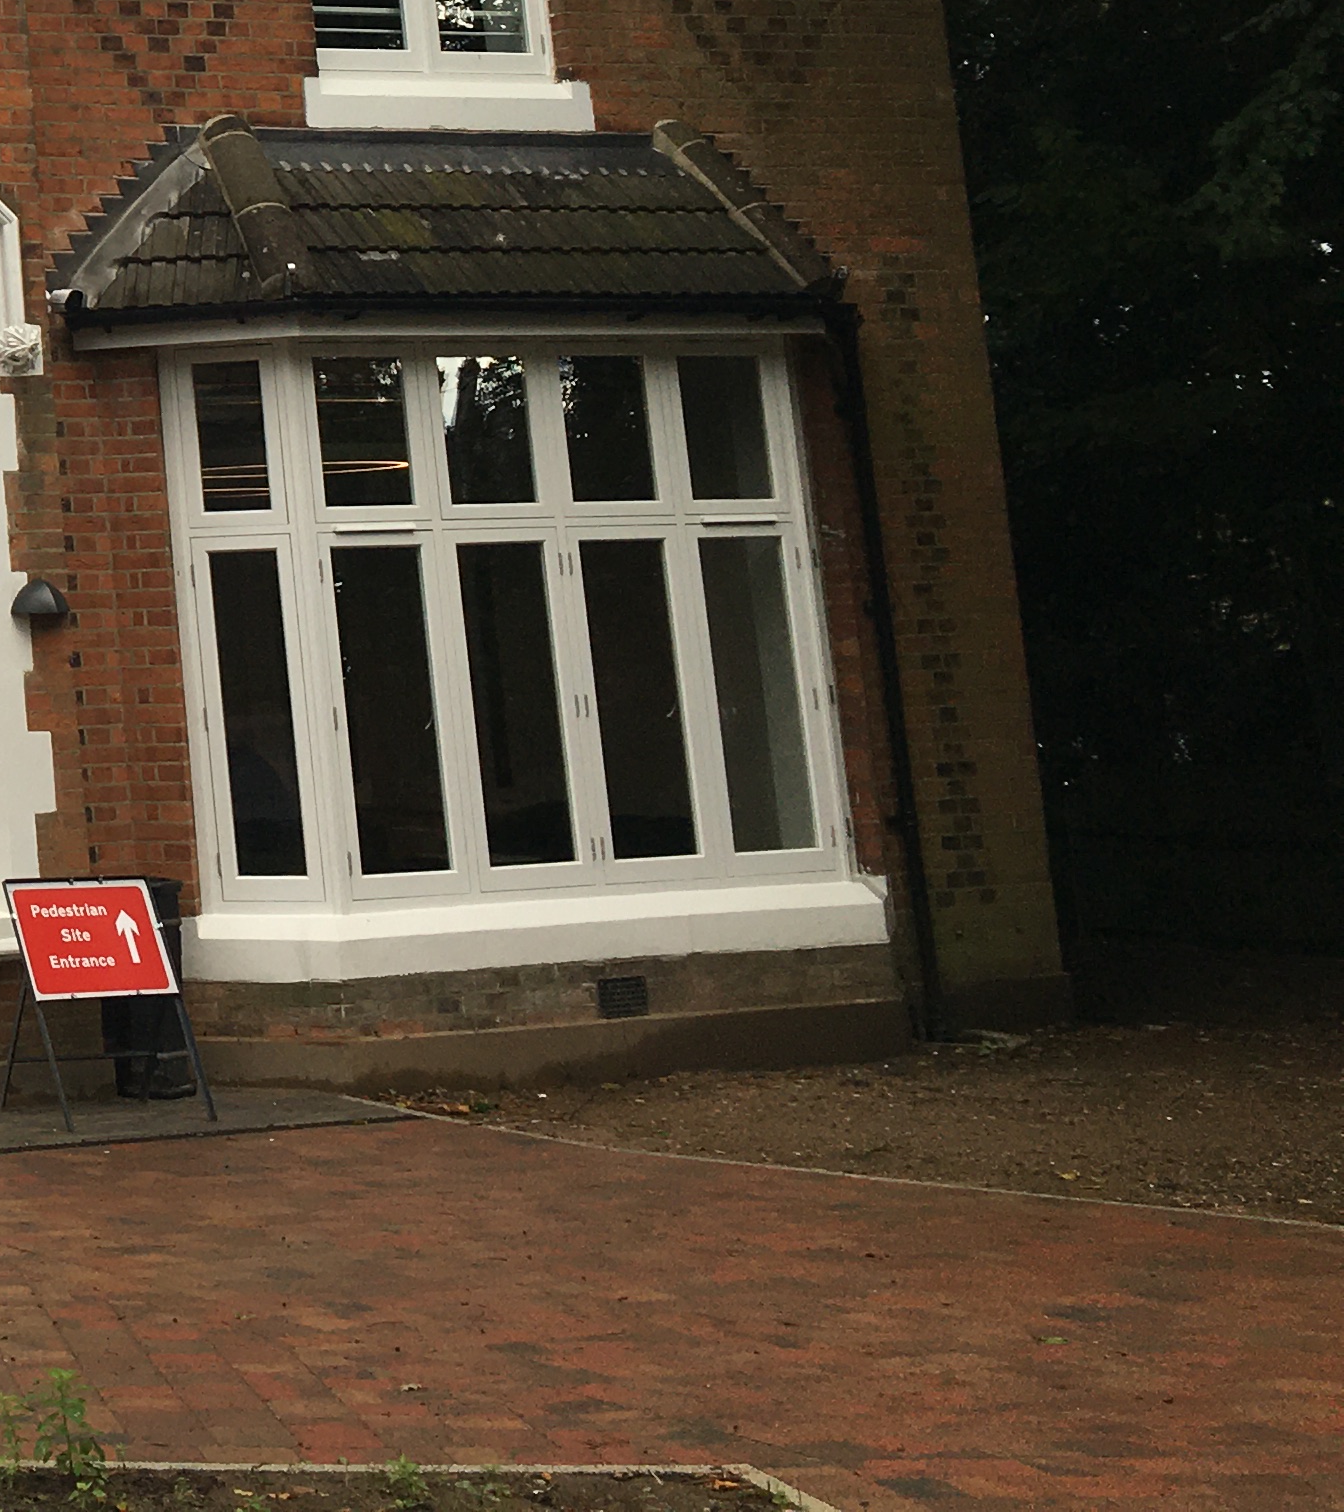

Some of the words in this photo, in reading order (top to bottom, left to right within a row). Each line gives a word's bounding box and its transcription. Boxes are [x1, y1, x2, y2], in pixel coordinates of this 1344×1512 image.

[30, 903, 108, 918] Pedestrian
[60, 928, 91, 942] Site
[48, 954, 116, 969] Entrance
